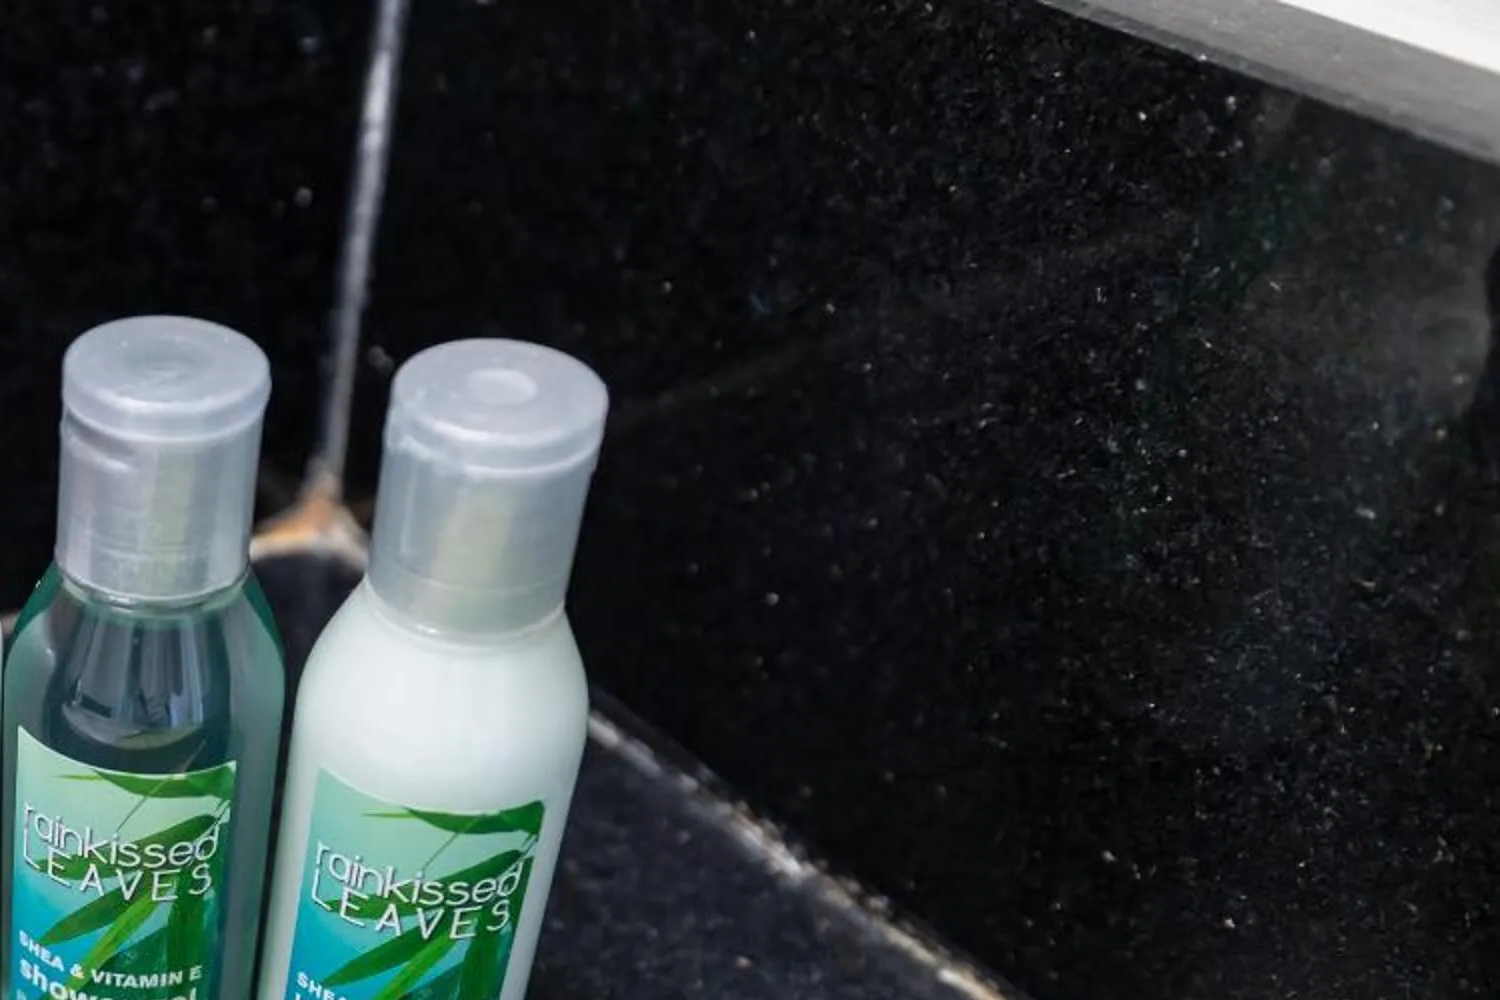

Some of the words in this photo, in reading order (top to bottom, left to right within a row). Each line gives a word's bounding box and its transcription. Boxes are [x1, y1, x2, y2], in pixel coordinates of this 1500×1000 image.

[21, 829, 214, 901] LEAVES
[23, 802, 221, 868] rainkissed
[311, 868, 510, 940] LEAVES
[315, 842, 525, 904] rainkissed
[19, 930, 65, 972] SHEA
[69, 963, 85, 980] &
[91, 968, 183, 989] VITAMIN
[190, 965, 202, 981] E
